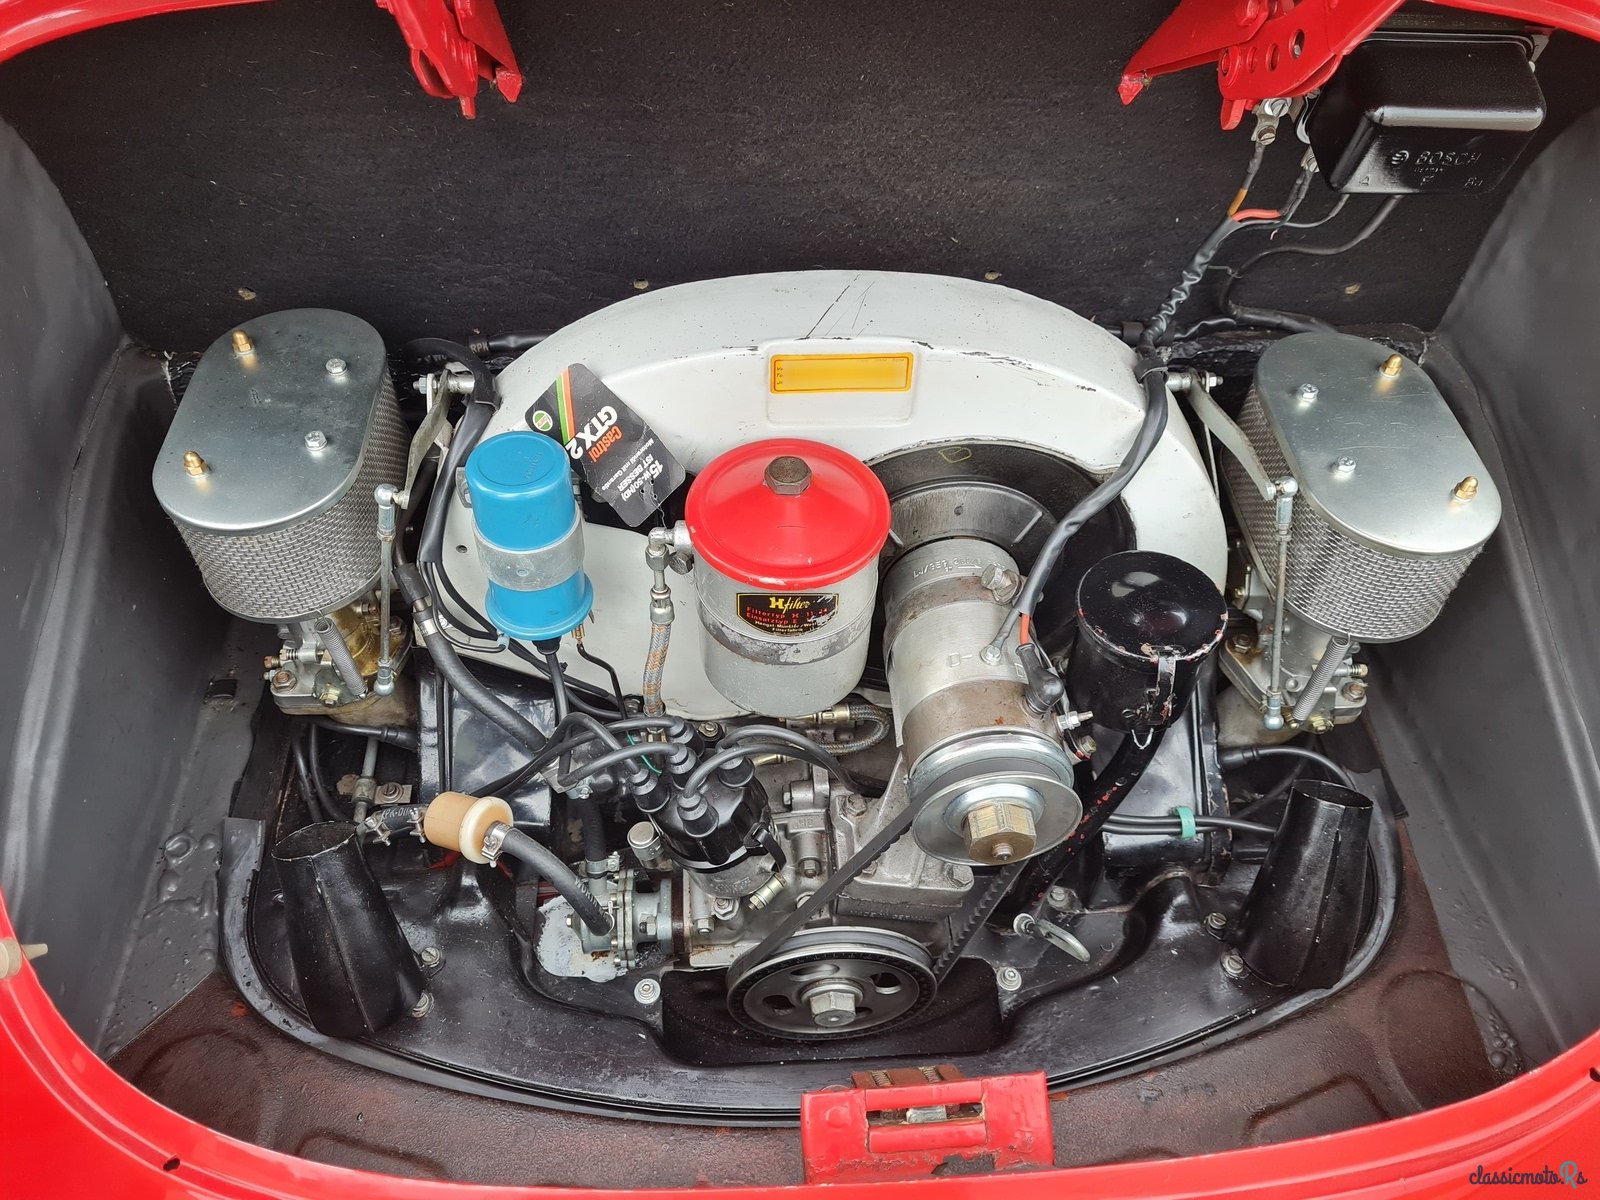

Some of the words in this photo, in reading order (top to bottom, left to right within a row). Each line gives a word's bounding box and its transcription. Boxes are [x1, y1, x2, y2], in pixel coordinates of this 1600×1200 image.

[1414, 150, 1482, 166] BOSCH
[575, 405, 618, 450] GTX
[564, 437, 584, 461] 2
[587, 425, 623, 462] Castrol
[620, 461, 631, 472] mit
[642, 453, 654, 467] IST
[601, 469, 623, 491] Garantie
[616, 463, 644, 491] BESSER
